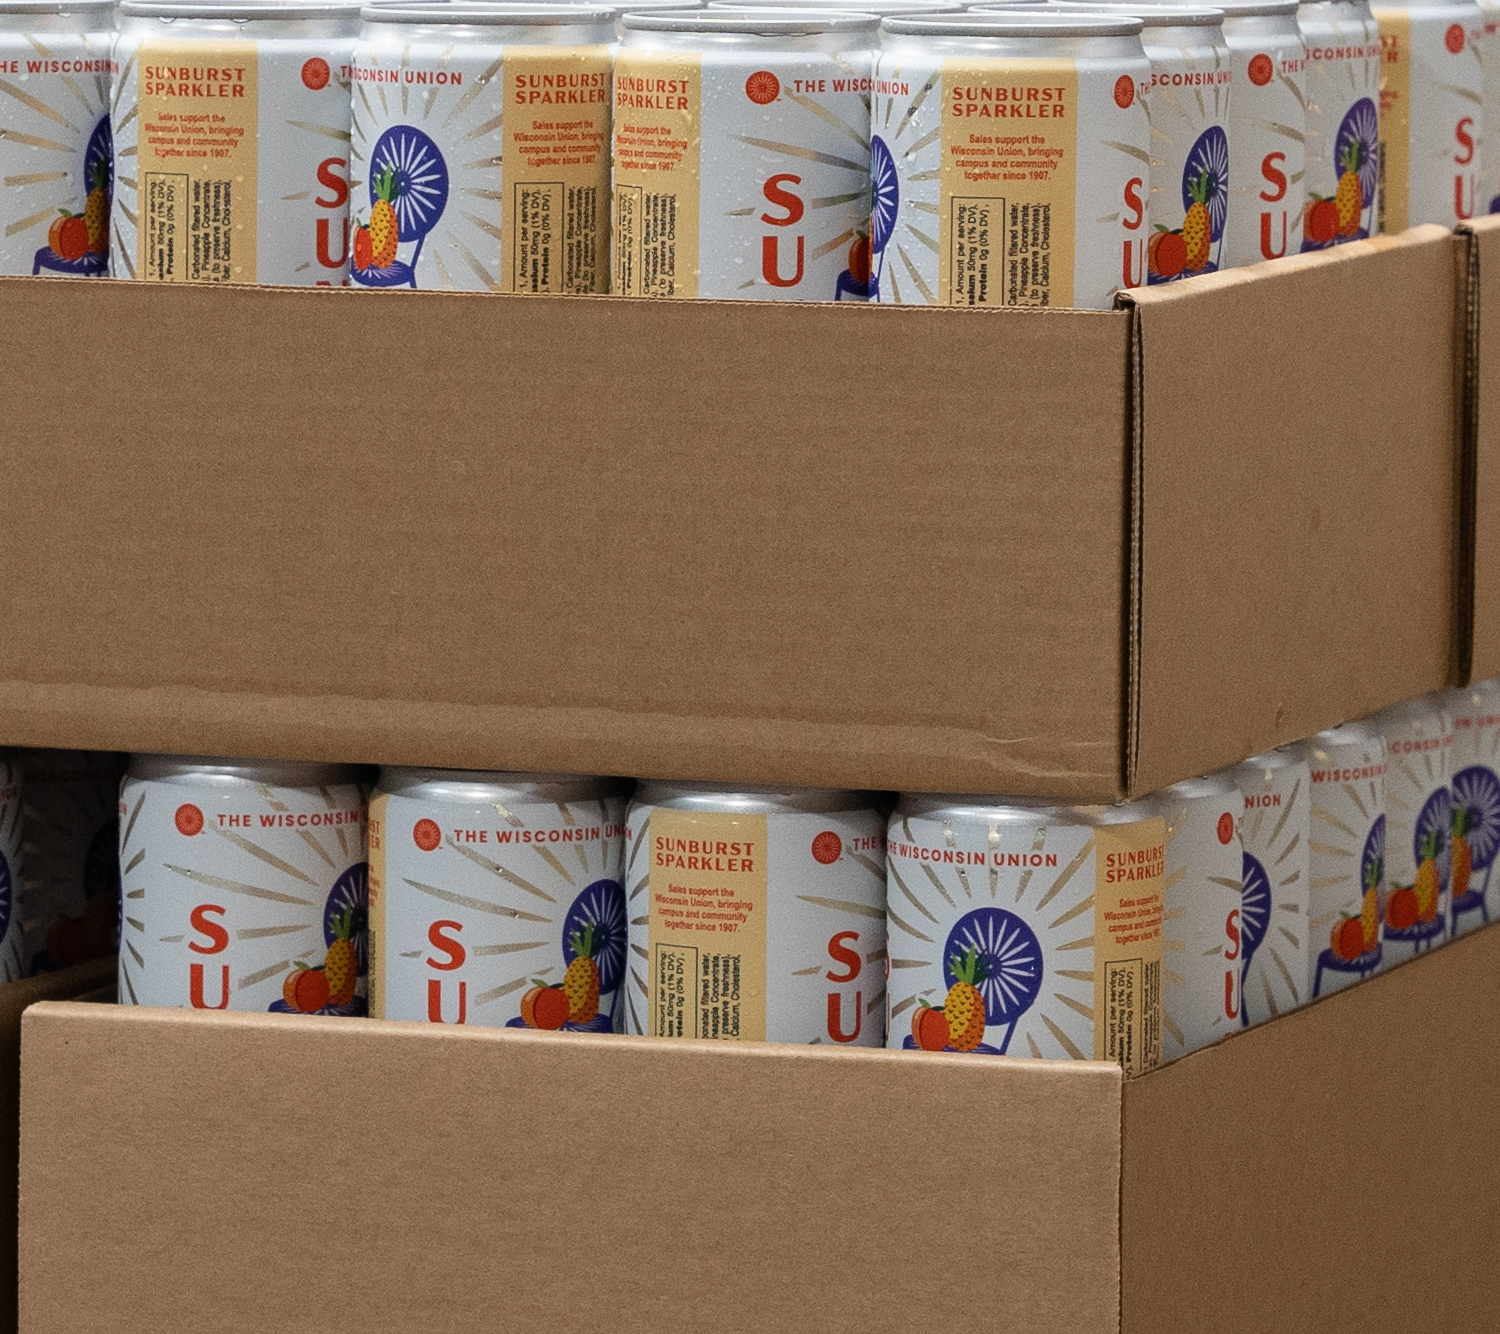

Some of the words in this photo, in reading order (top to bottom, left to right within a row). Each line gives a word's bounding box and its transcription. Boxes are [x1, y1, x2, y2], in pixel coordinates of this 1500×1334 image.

[145, 66, 245, 81] SUNBURST
[405, 70, 462, 85] UNION
[515, 73, 605, 88] SUNBURST
[145, 82, 245, 98] SPARKLER
[617, 76, 689, 93] SUNBURST
[794, 79, 826, 92] THE
[515, 89, 605, 104] SPARKLER
[952, 86, 1066, 101] SUNBURST
[617, 93, 689, 110] SPARKLER
[952, 103, 1066, 118] SPARKLER
[969, 134, 992, 144] Sales
[995, 134, 1030, 145] support
[1032, 134, 1045, 144] the
[951, 145, 994, 156] Wisconsin
[1028, 147, 1063, 158] bringing
[956, 159, 989, 169] campus
[992, 159, 1008, 167] and
[1010, 159, 1058, 170] community
[964, 171, 999, 181] together
[1003, 171, 1026, 180] since
[1244, 794, 1281, 809] NION
[218, 814, 251, 827] THE
[259, 810, 358, 827] WISCONSIN
[454, 829, 488, 843] THE
[496, 827, 600, 844] WISCONSIN
[656, 837, 754, 856] SUNBURST
[853, 837, 878, 852] THE
[900, 842, 985, 866] WISCONSIN
[994, 853, 1057, 866] UNION
[656, 853, 754, 872] SPARKLER
